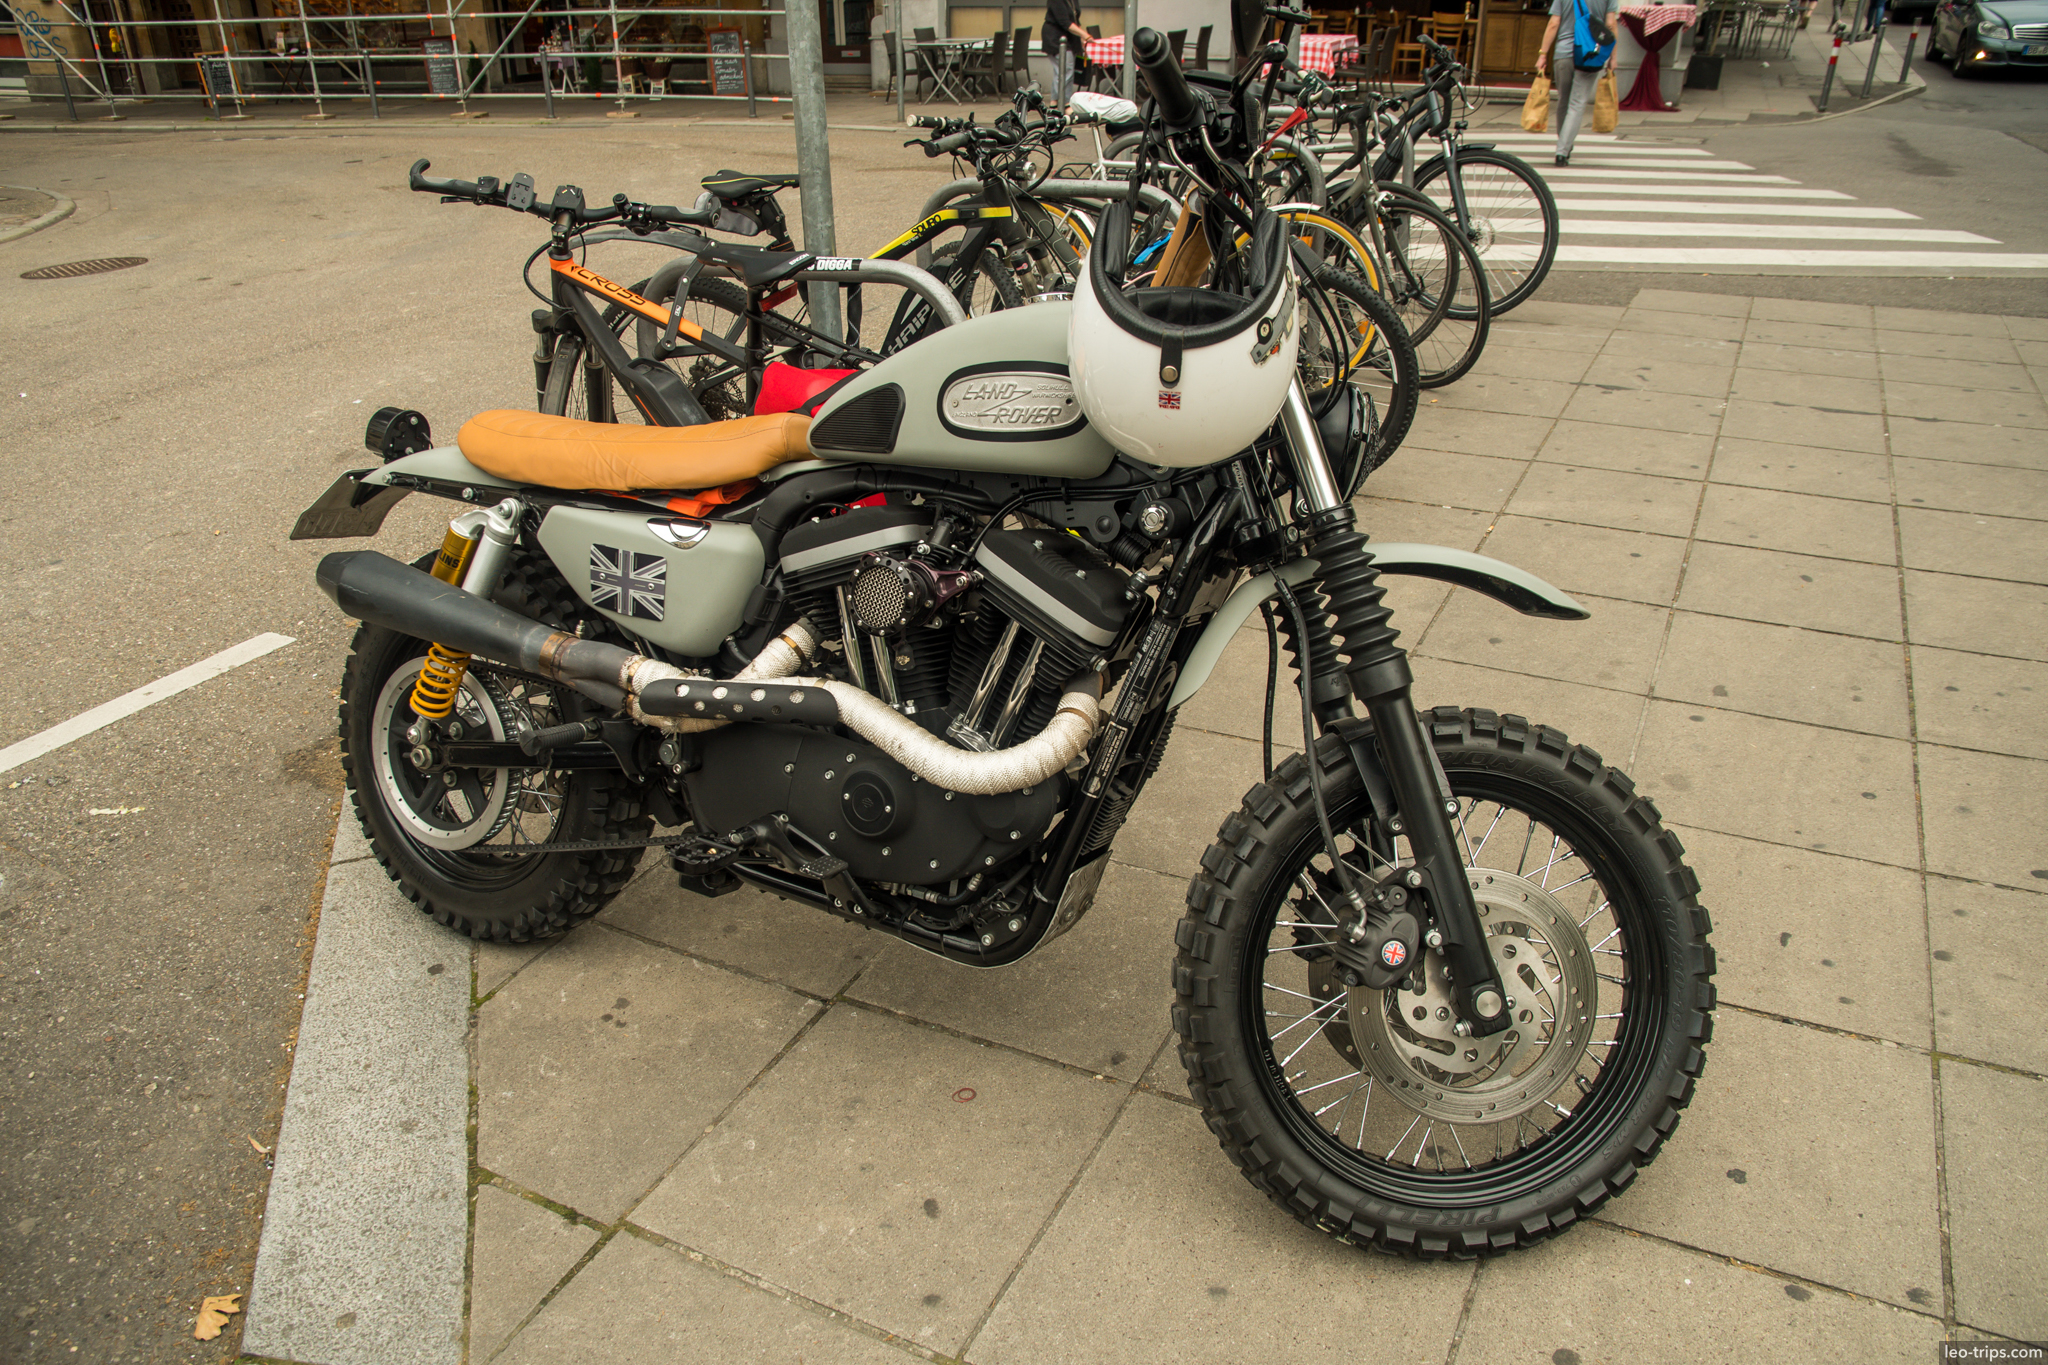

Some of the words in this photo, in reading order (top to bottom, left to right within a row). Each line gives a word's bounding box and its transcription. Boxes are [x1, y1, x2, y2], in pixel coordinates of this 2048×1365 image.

[816, 259, 853, 271] DIGGA
[962, 381, 1018, 401] LAND
[993, 405, 1063, 424] ROVER
[1524, 763, 1634, 835] RALLY
[1357, 1200, 1501, 1227] PIRELLI
